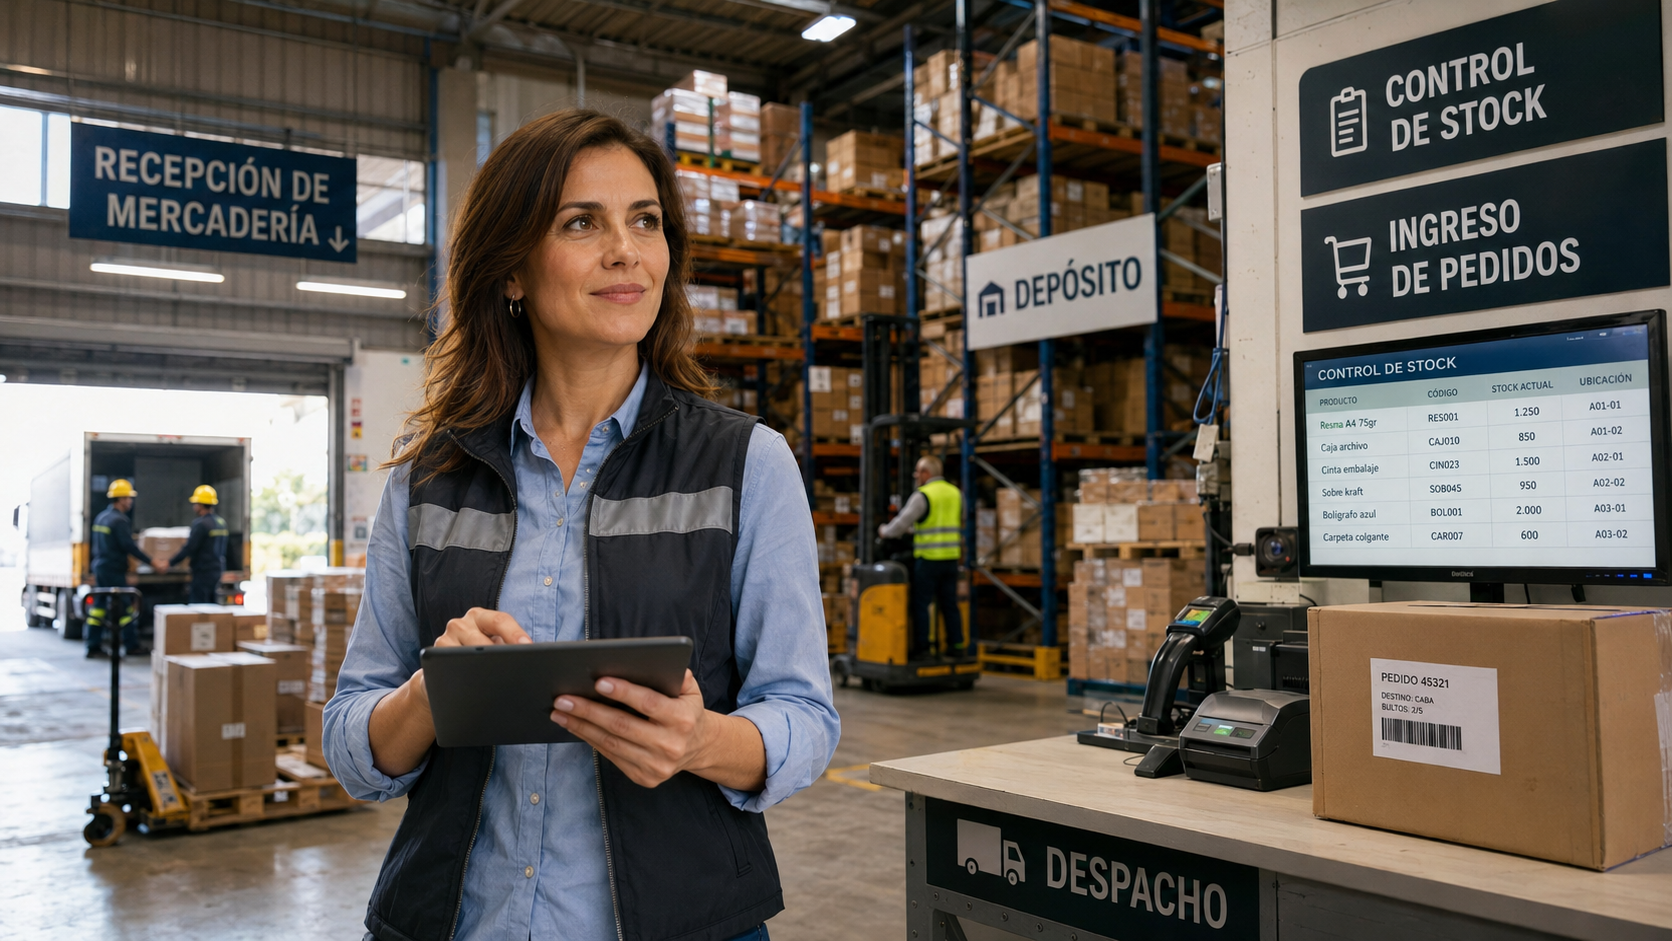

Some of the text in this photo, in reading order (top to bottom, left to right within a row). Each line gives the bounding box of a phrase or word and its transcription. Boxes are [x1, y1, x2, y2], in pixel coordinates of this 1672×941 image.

[1385, 41, 1535, 108] CONTROL
[1391, 84, 1547, 152] DE STOCK
[94, 145, 330, 205] RECEPCIÓN DE
[106, 192, 320, 245] MERCADERÍA
[1389, 198, 1521, 253] INGRESO
[1392, 237, 1581, 298] DE PEDIDOS
[1015, 256, 1142, 310] DEPÓSITO
[1318, 356, 1457, 381] CONTROL DE STOCK
[1579, 372, 1632, 386] UBICACIÓN
[1491, 380, 1554, 393] STOCK ACTUAL
[1427, 388, 1458, 398] CÓDIGO
[1319, 396, 1358, 406] PRODUCTO
[1589, 400, 1621, 411] A01-01
[1428, 412, 1459, 422] RES001
[1514, 406, 1540, 417] 1.250
[1345, 419, 1356, 428] A4
[1358, 418, 1377, 429] 75gr
[1590, 425, 1623, 436] A01-02
[1428, 436, 1460, 446] CAJ010
[1518, 431, 1536, 442] 850
[1321, 441, 1369, 454] Caja archivo
[1515, 456, 1540, 466] 1.500
[1591, 452, 1624, 462] A02-01
[1321, 464, 1379, 475] Cinta embalaje
[1429, 460, 1460, 470] CIN023
[1519, 480, 1537, 490] 950
[1593, 477, 1625, 488] A02-02
[1322, 487, 1364, 497] Sobre kraft
[1429, 484, 1462, 494] SOB045
[1430, 507, 1463, 517] BOL001
[1516, 505, 1542, 515] 2.000
[1594, 503, 1626, 513] A03-01
[1359, 509, 1377, 519] azul
[1322, 532, 1390, 544] Carpeta colgante
[1430, 531, 1464, 541] CAR007
[1520, 530, 1539, 540] 600
[1595, 529, 1628, 539] A03-02
[1381, 672, 1450, 689] PEDIDO 45321
[1381, 691, 1434, 704] DESTINO: CABA
[1411, 706, 1424, 715] 2/5
[1046, 845, 1228, 929] DESPACHO
